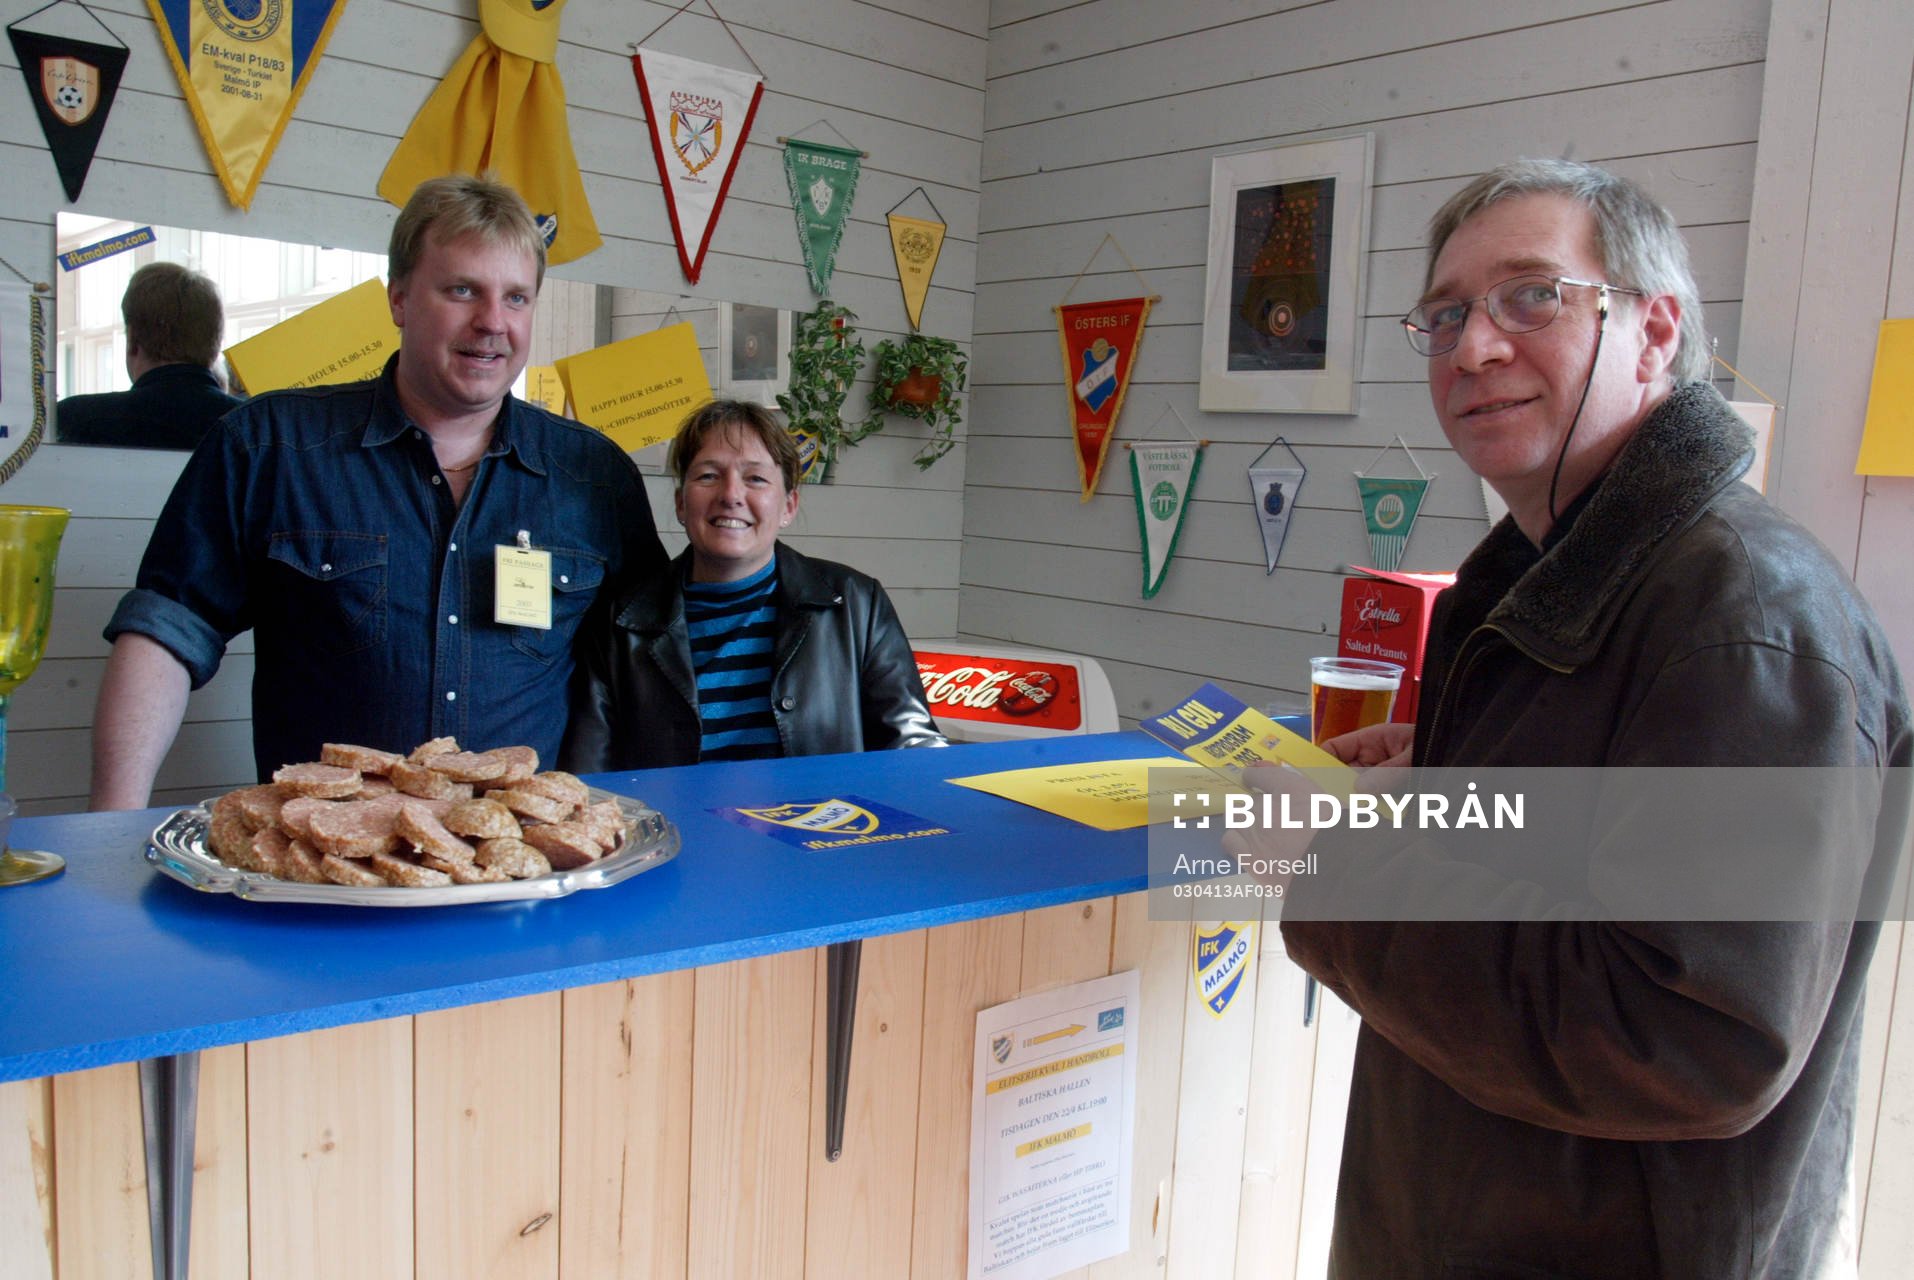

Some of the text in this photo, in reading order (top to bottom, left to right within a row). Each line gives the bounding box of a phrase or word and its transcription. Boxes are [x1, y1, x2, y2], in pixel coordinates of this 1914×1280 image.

[202, 43, 285, 72] EM-kval P18/83
[214, 61, 241, 74] Sverige
[247, 69, 272, 80] Turkiet
[224, 74, 250, 87] Malmö
[797, 153, 847, 170] IK BRAGE
[65, 231, 150, 267] ifkmalmo.com
[1075, 314, 1131, 330] ÖSTERS IF
[308, 363, 338, 384] HOUR
[591, 400, 618, 414] HAPPY
[619, 390, 645, 404] HOUR
[1359, 599, 1401, 623] Estrella
[1345, 638, 1408, 661] Salted Peanuts
[1009, 678, 1051, 704] Coca-Cola
[802, 807, 850, 827] MALMÖ
[802, 827, 949, 850] ifkmalmo.com
[1200, 939, 1220, 957] IFK
[1204, 939, 1247, 992] MALMÖ
[998, 1062, 1061, 1089] ELITSERIEKVAL
[1067, 1048, 1111, 1068] HANDBOLL
[1018, 1077, 1091, 1107] BALTISKA HALLEN
[1001, 1119, 1041, 1138] TISDAGEN
[1042, 1111, 1060, 1123] DEN
[1029, 1127, 1077, 1151] IFK MALMÖ
